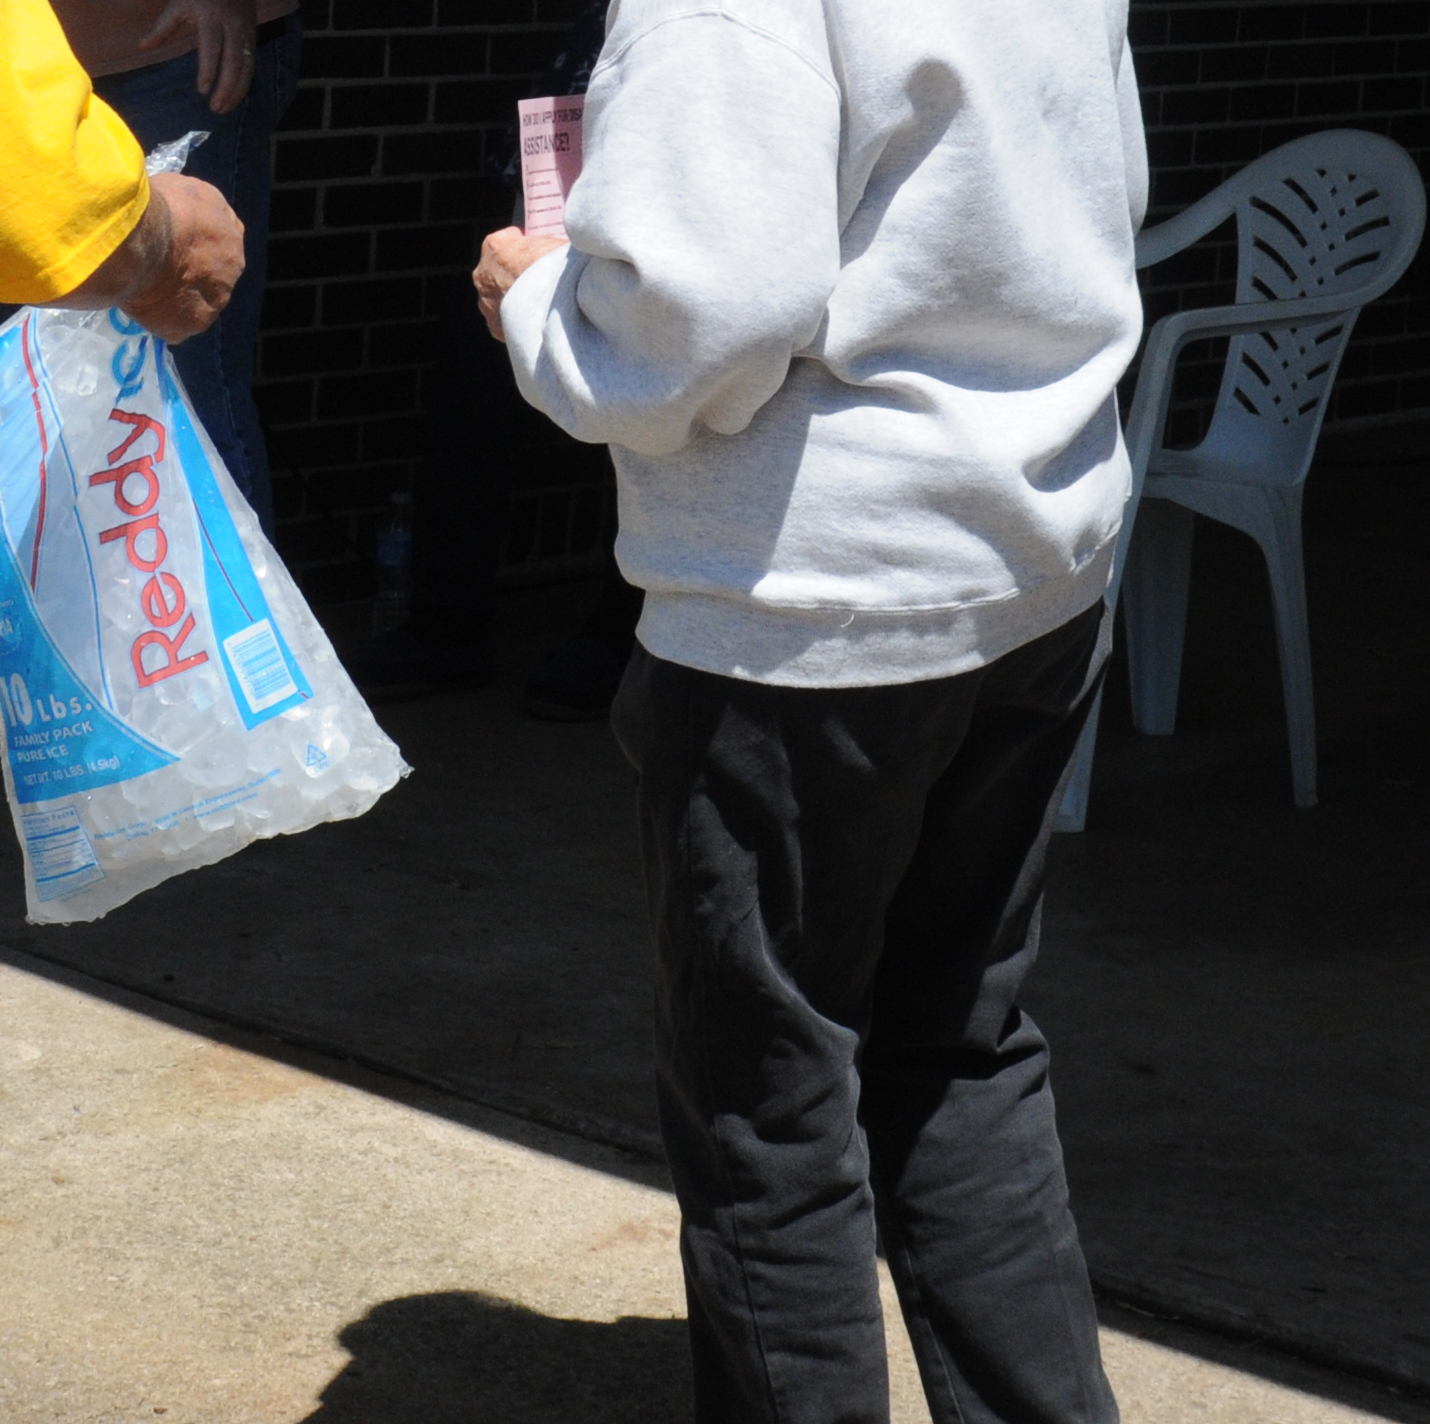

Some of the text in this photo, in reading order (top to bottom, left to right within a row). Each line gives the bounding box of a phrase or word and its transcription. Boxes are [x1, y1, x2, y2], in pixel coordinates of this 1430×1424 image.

[88, 408, 209, 689] Reddy
[14, 721, 94, 747] FAMILY PACK
[17, 744, 69, 763] PURE ICE
